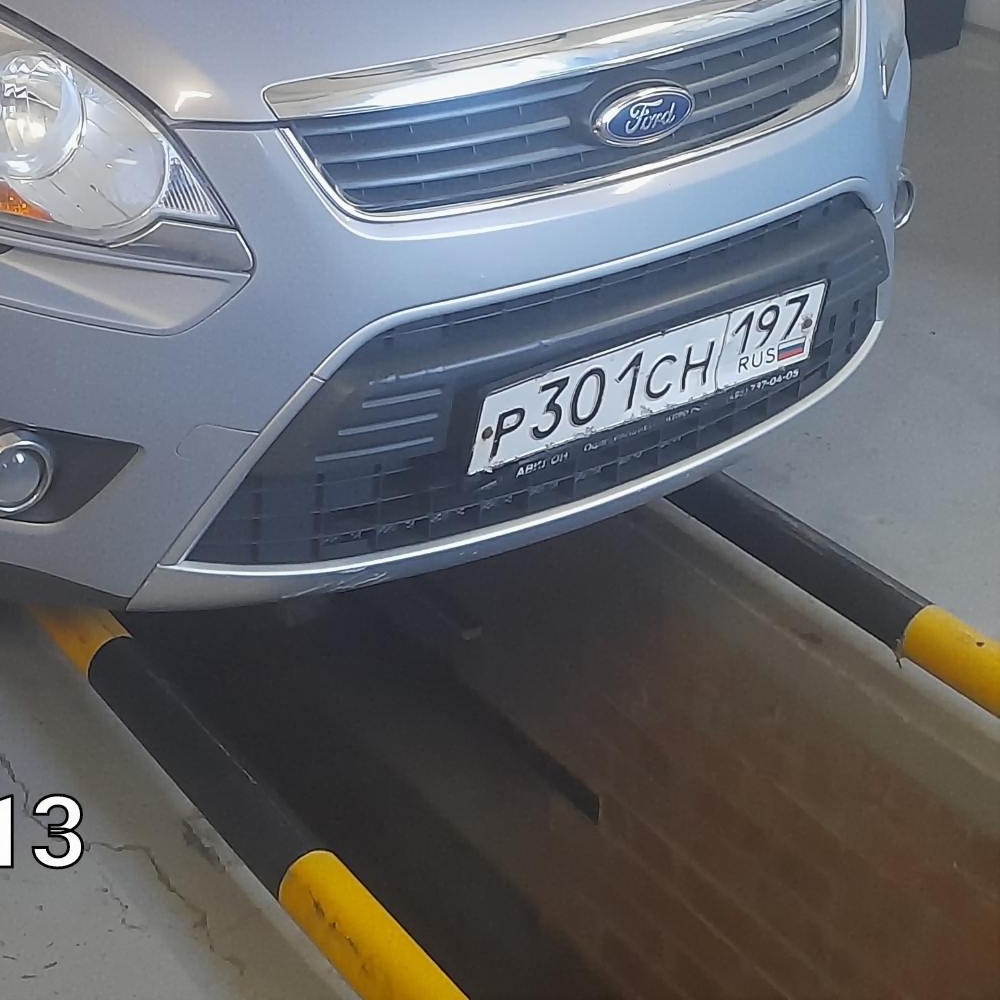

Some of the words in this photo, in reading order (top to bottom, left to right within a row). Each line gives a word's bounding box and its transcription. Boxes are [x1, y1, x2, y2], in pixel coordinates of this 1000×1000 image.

[625, 99, 676, 134] Ford
[731, 293, 810, 354] 197
[737, 348, 776, 373] RUS
